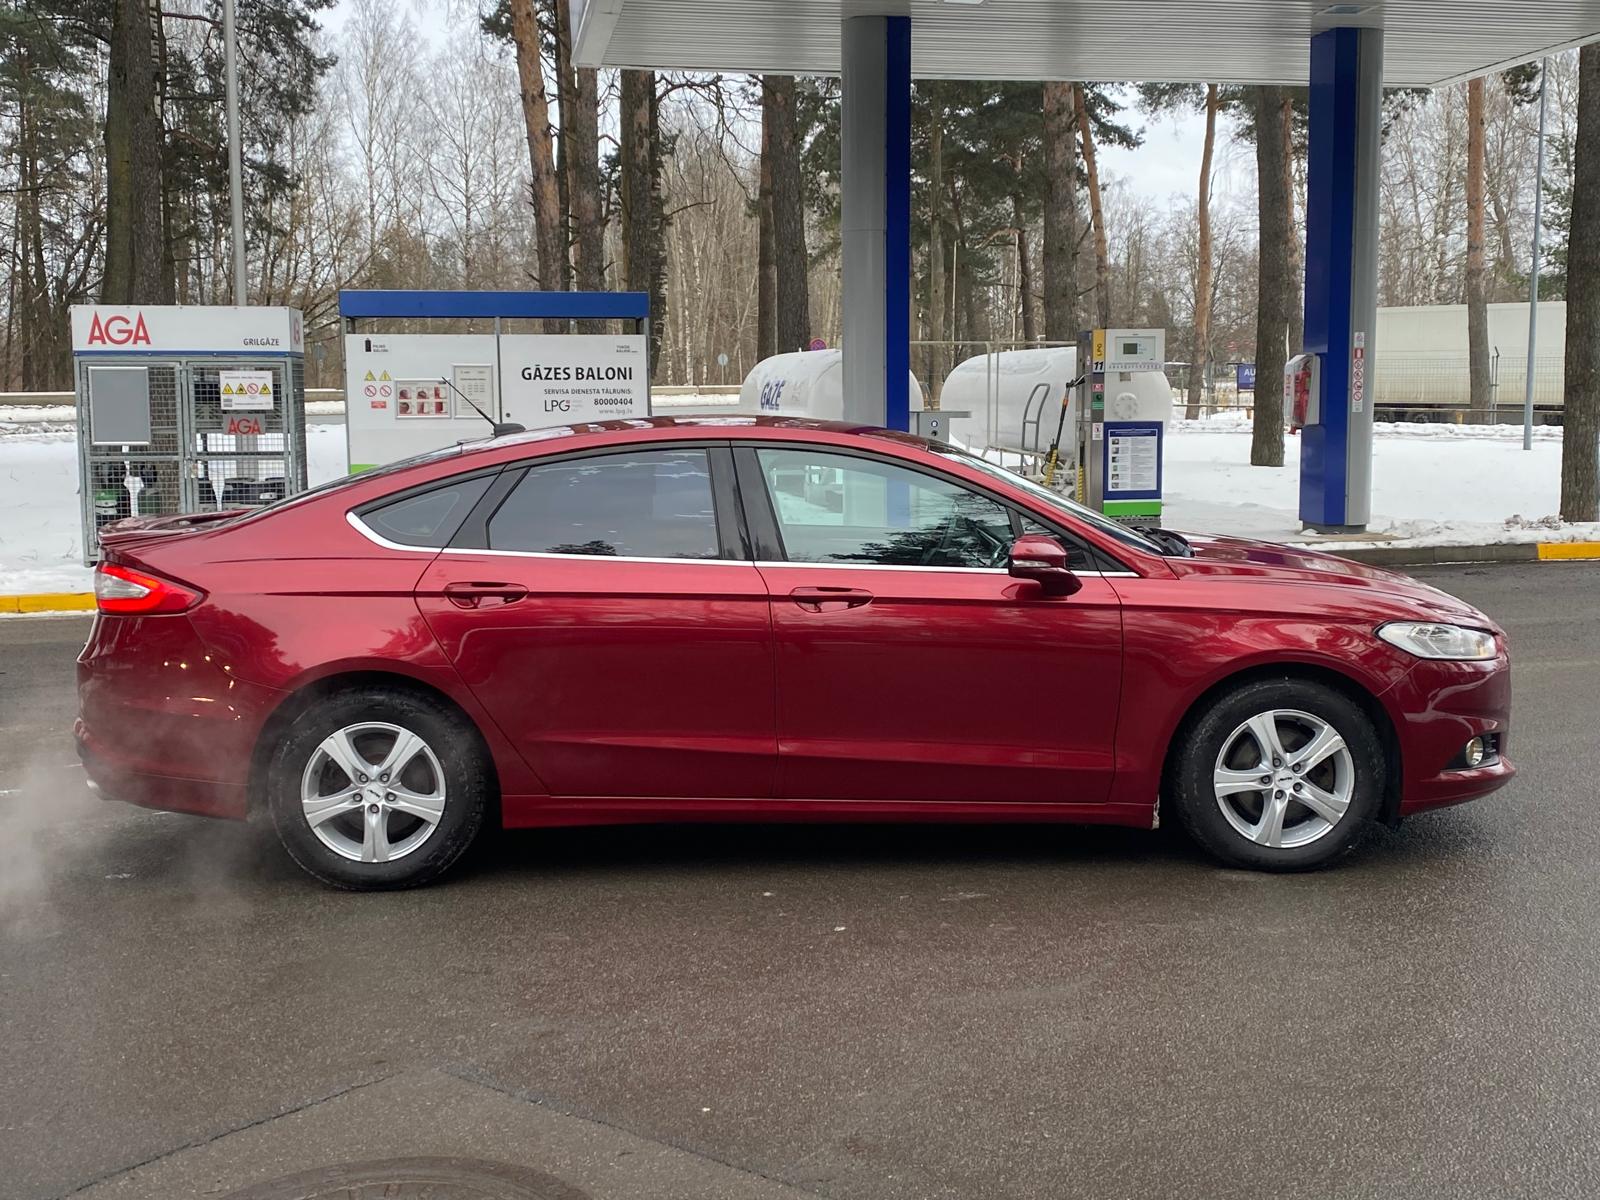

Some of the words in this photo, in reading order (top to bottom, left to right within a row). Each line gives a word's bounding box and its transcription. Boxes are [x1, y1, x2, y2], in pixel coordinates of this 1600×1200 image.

[88, 311, 151, 345] AGA
[243, 337, 280, 346] GRILGĀZE
[521, 364, 571, 380] GĀZES
[575, 367, 633, 380] BALONI
[1094, 361, 1104, 371] 11
[544, 399, 571, 412] LPG
[593, 398, 633, 406] 80000404
[228, 416, 262, 435] AGA
